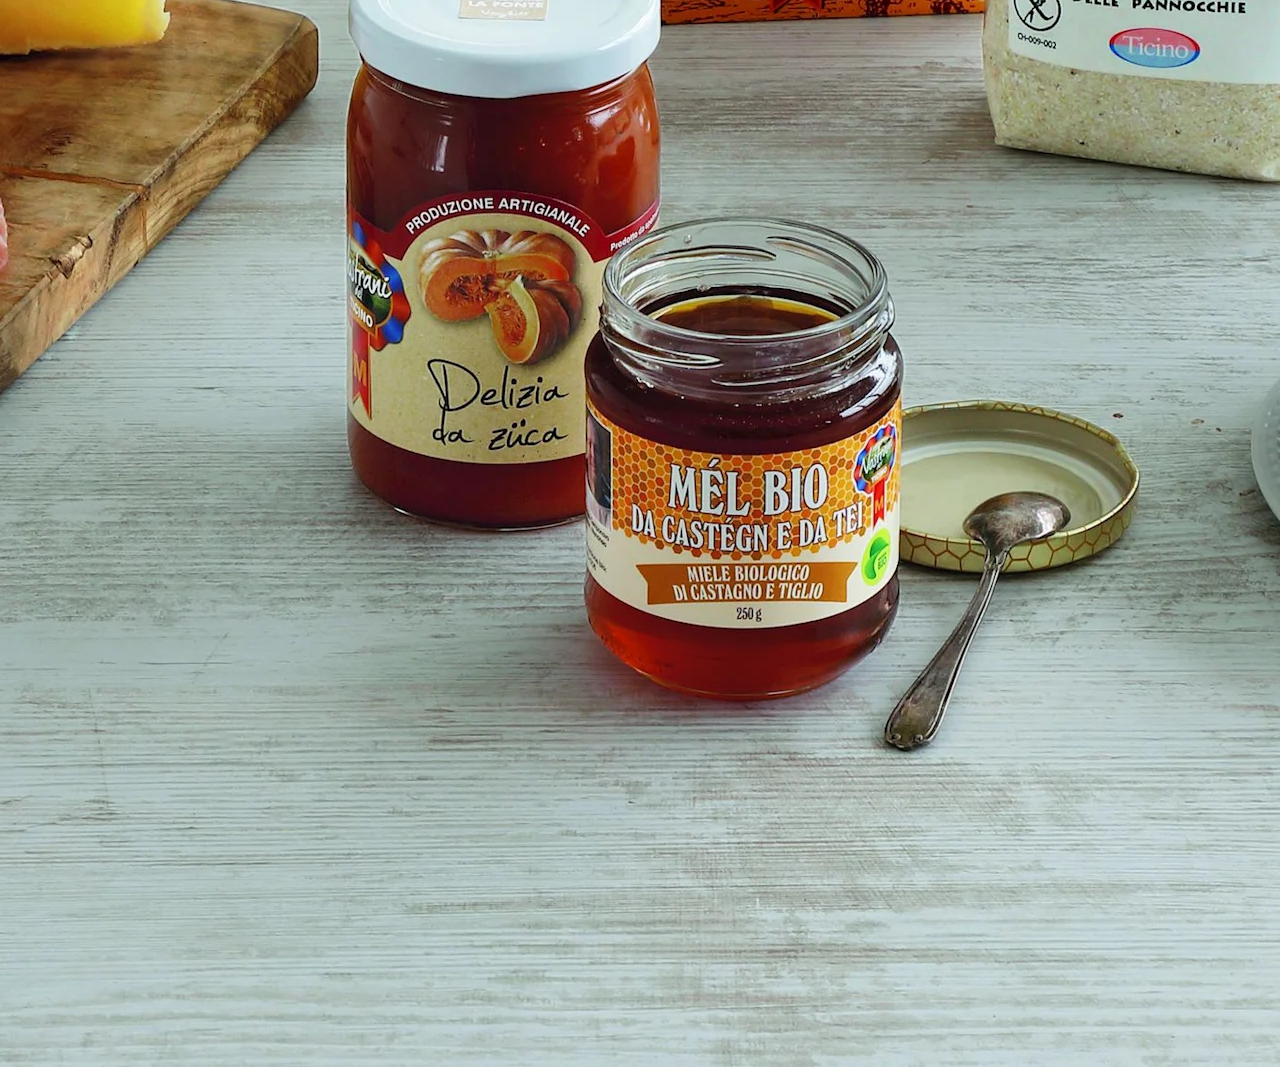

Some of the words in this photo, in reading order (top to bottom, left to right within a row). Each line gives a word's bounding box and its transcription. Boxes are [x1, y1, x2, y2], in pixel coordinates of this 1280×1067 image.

[1122, 34, 1190, 60] Ticino
[405, 197, 495, 234] PRODUZIONE
[498, 197, 591, 238] ARTIGIANALE
[610, 231, 638, 251] Prodotto
[354, 350, 367, 387] M
[426, 358, 570, 412] Delizia
[432, 409, 473, 446] da
[488, 419, 569, 451] züca
[667, 458, 752, 517] MÉL
[763, 463, 829, 517] BIO
[874, 495, 884, 514] M
[631, 503, 655, 538] DA
[661, 511, 768, 552] CASTÉGN
[776, 521, 792, 550] E
[798, 513, 828, 547] DA
[832, 500, 864, 538] TEI
[686, 564, 731, 582] MIELE
[734, 564, 811, 582] BIOLOGICO
[672, 583, 688, 601] DI
[690, 582, 762, 601] CASTAGNO
[765, 583, 775, 600] E
[778, 582, 824, 600] TIGLIO
[735, 607, 754, 621] 250
[755, 609, 763, 623] g
